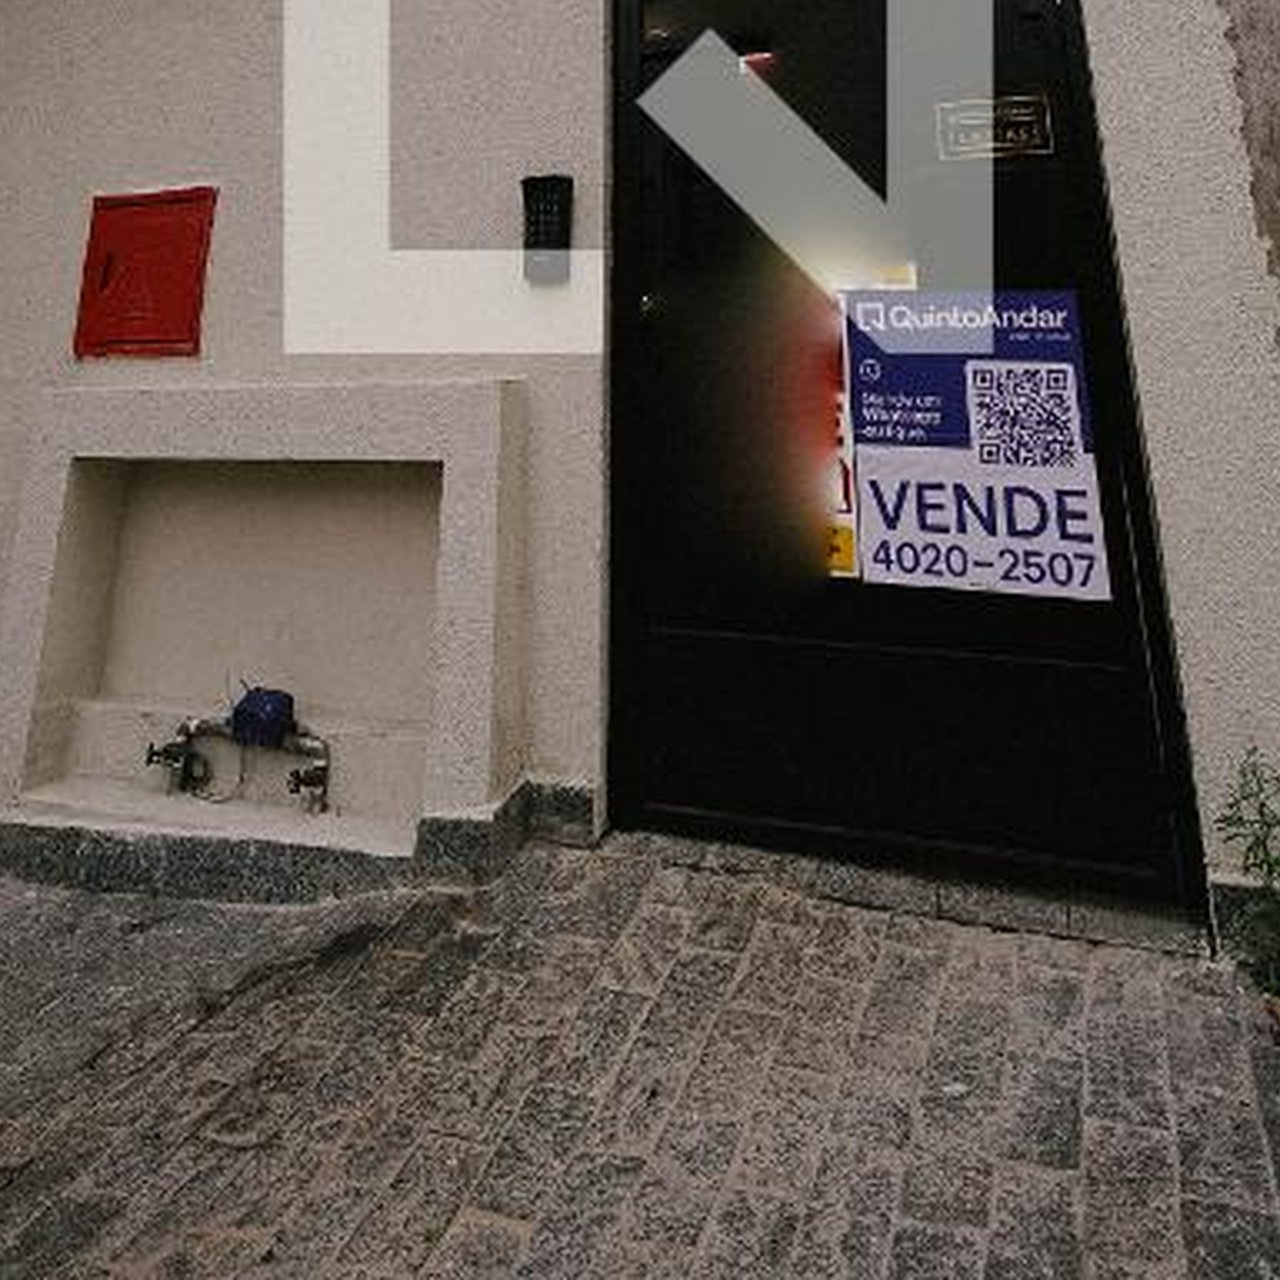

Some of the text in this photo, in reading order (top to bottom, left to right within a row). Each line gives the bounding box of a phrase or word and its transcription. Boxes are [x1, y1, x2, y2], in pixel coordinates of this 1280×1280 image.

[888, 303, 1067, 331] QuintoAndar
[869, 480, 1094, 544] VENDE
[873, 539, 1095, 588] 4020-2507
